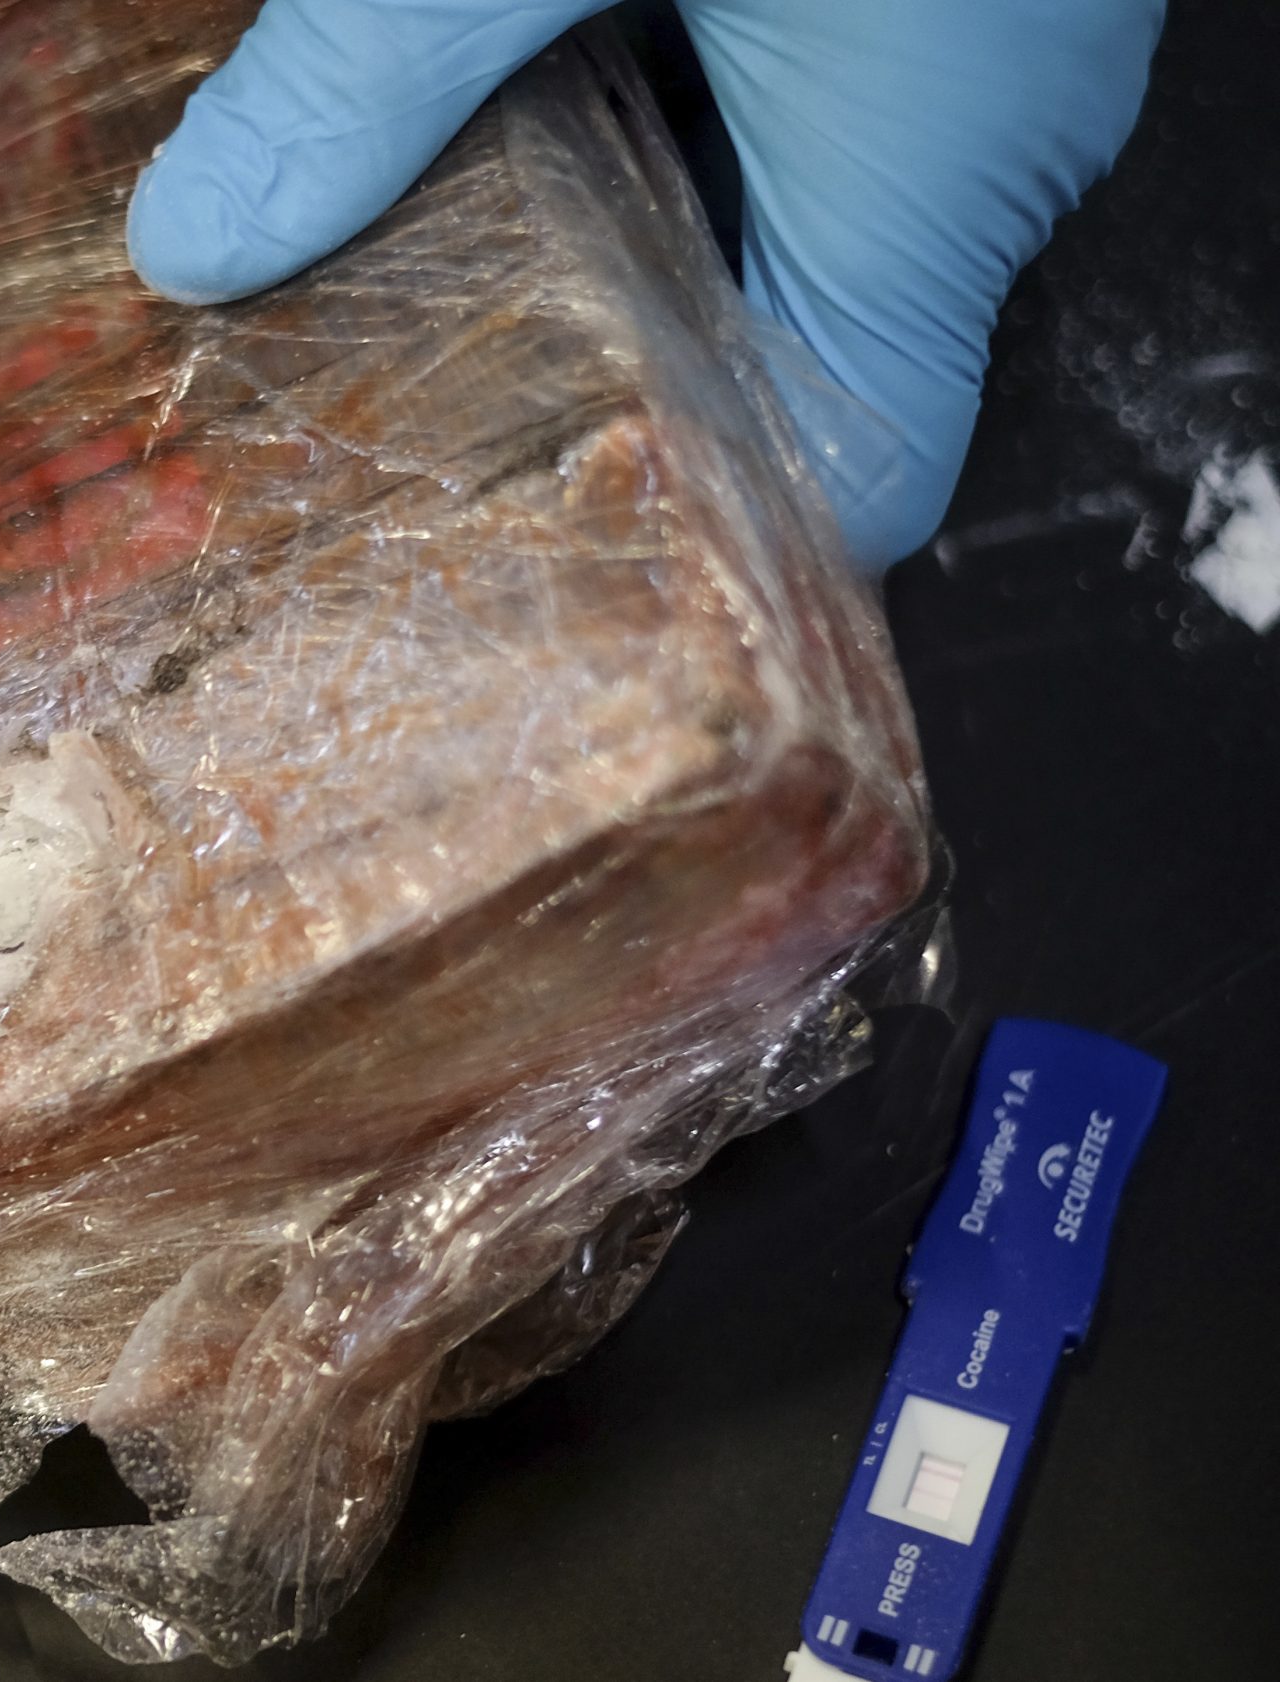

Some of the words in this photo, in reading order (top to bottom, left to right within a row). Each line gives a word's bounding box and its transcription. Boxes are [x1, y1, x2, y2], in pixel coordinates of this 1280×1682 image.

[1053, 1109, 1115, 1242] SECURETEC
[956, 1308, 1001, 1390] Cocaine
[877, 1542, 922, 1618] PRESS
